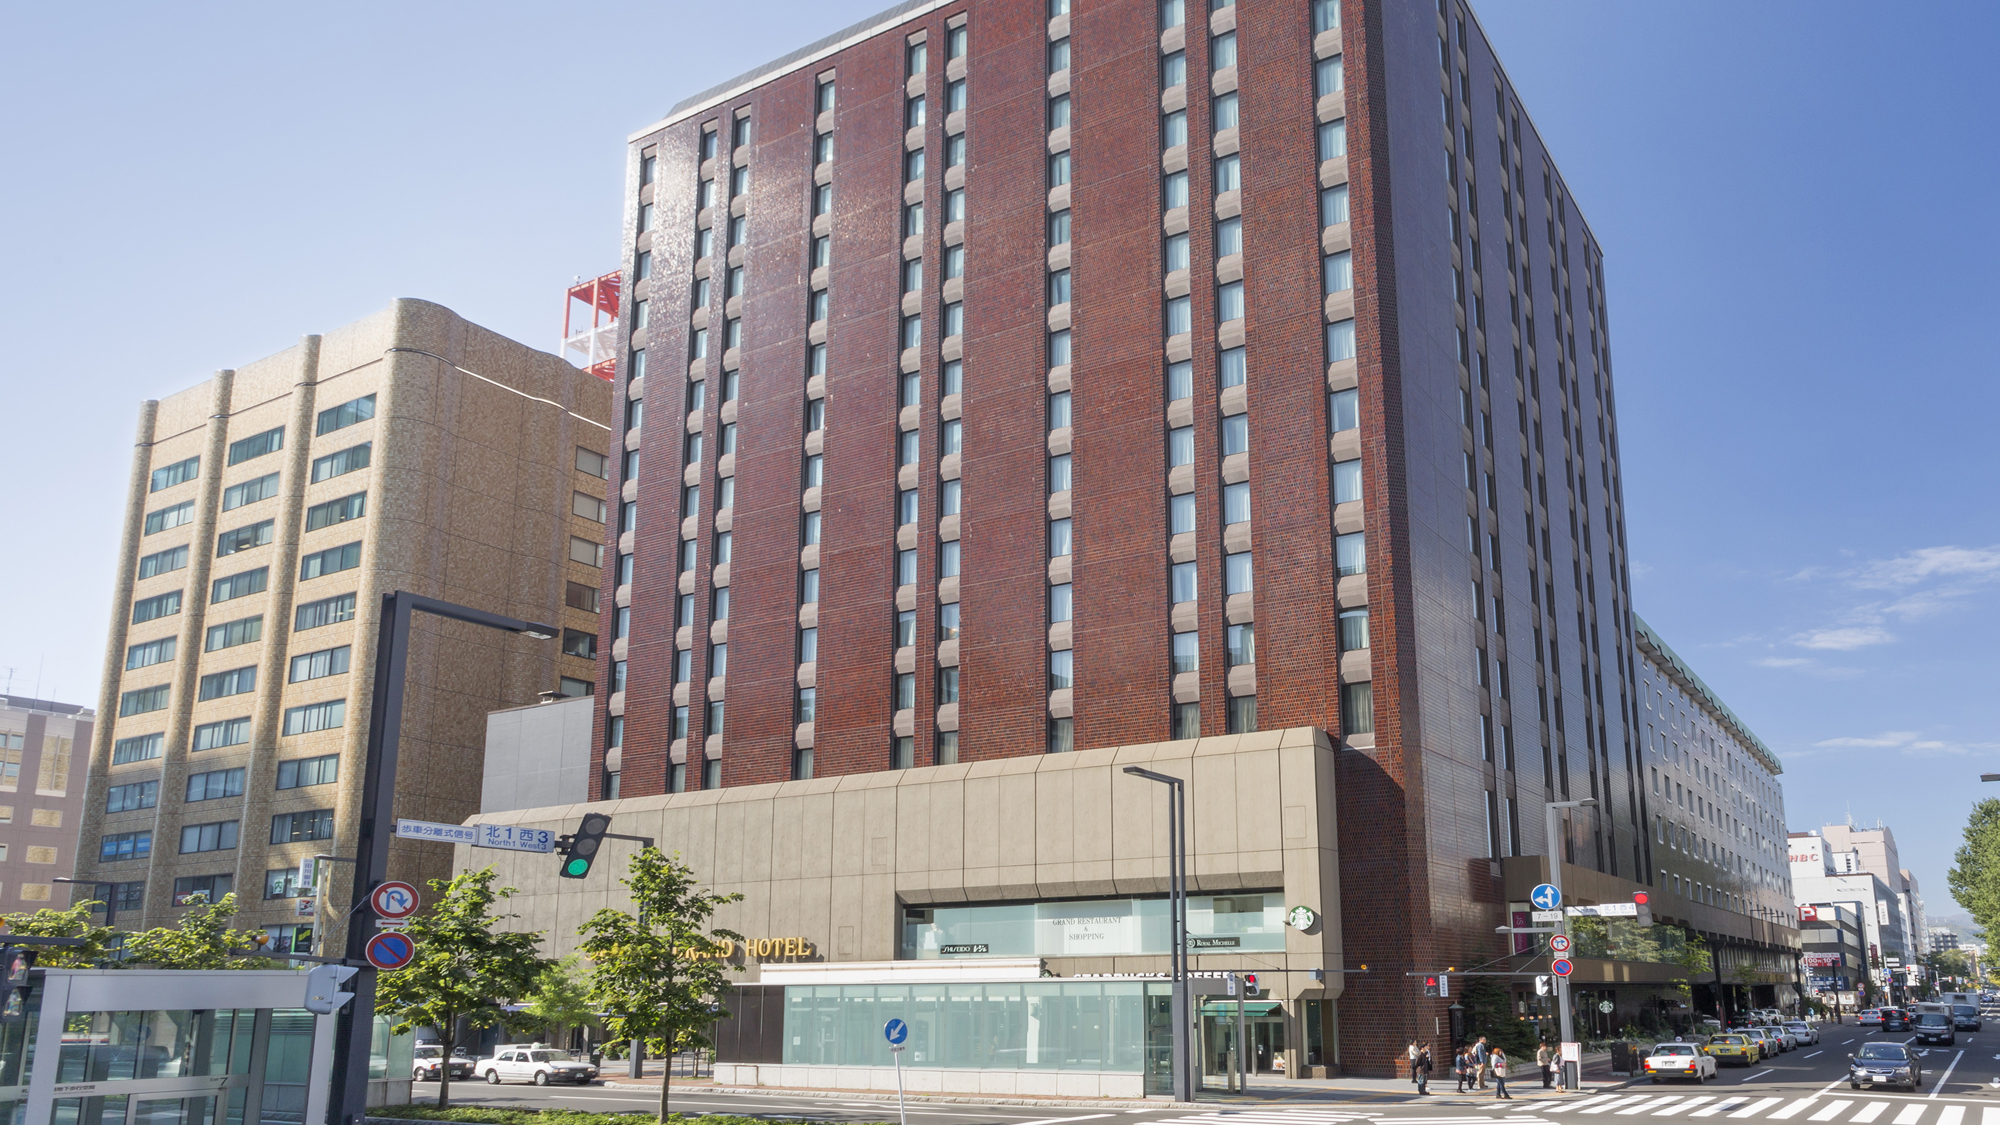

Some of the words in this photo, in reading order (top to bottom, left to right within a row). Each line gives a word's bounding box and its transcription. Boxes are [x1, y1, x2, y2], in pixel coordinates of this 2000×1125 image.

[401, 825, 474, 840] 歩車分離式信号
[486, 825, 549, 844] 北1西3
[1052, 918, 1075, 926] GRAND
[1077, 916, 1122, 925] RESTAURANT
[1801, 907, 1815, 920] P
[745, 937, 812, 957] HOTEL
